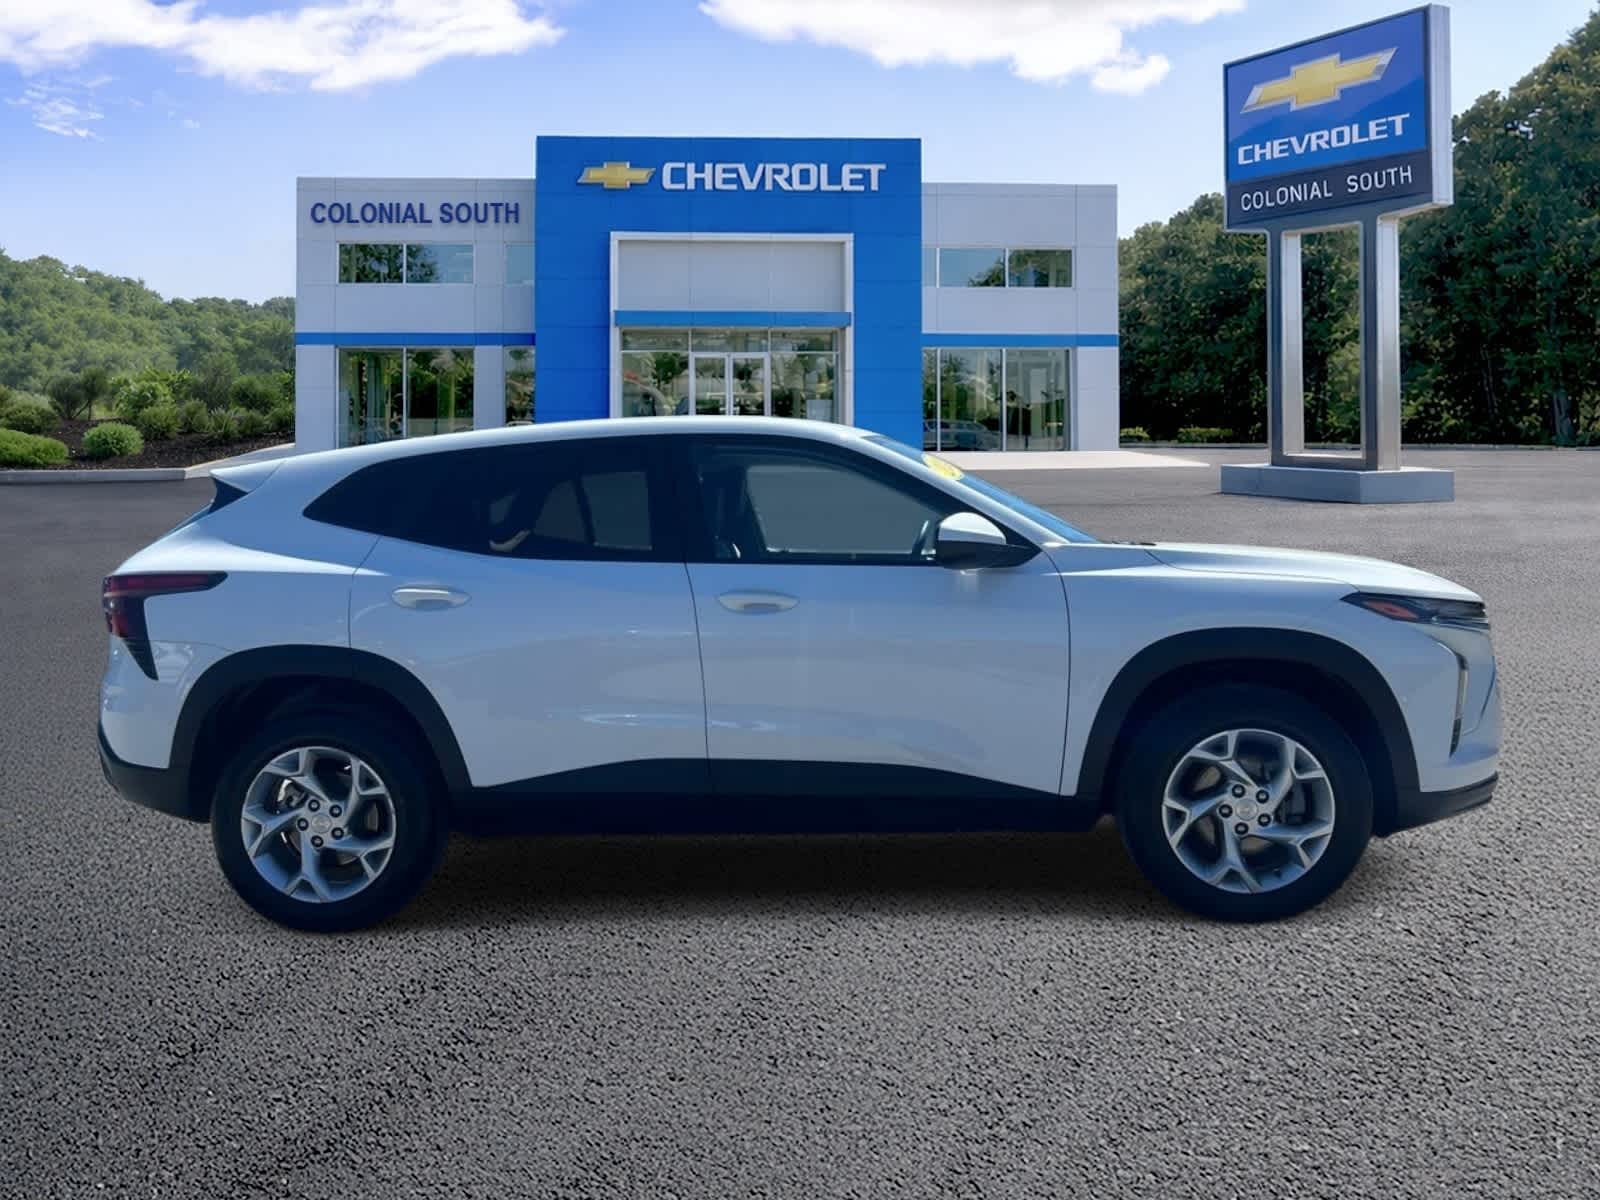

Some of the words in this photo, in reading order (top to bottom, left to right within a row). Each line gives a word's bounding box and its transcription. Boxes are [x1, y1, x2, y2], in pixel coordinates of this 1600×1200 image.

[1237, 113, 1410, 165] CHEVROLET
[661, 162, 887, 192] CHEVROLET
[1240, 179, 1333, 212] COLONIAL
[1346, 165, 1413, 194] SOUTH
[310, 202, 432, 225] COLONIAL
[439, 202, 520, 225] SOUTH
